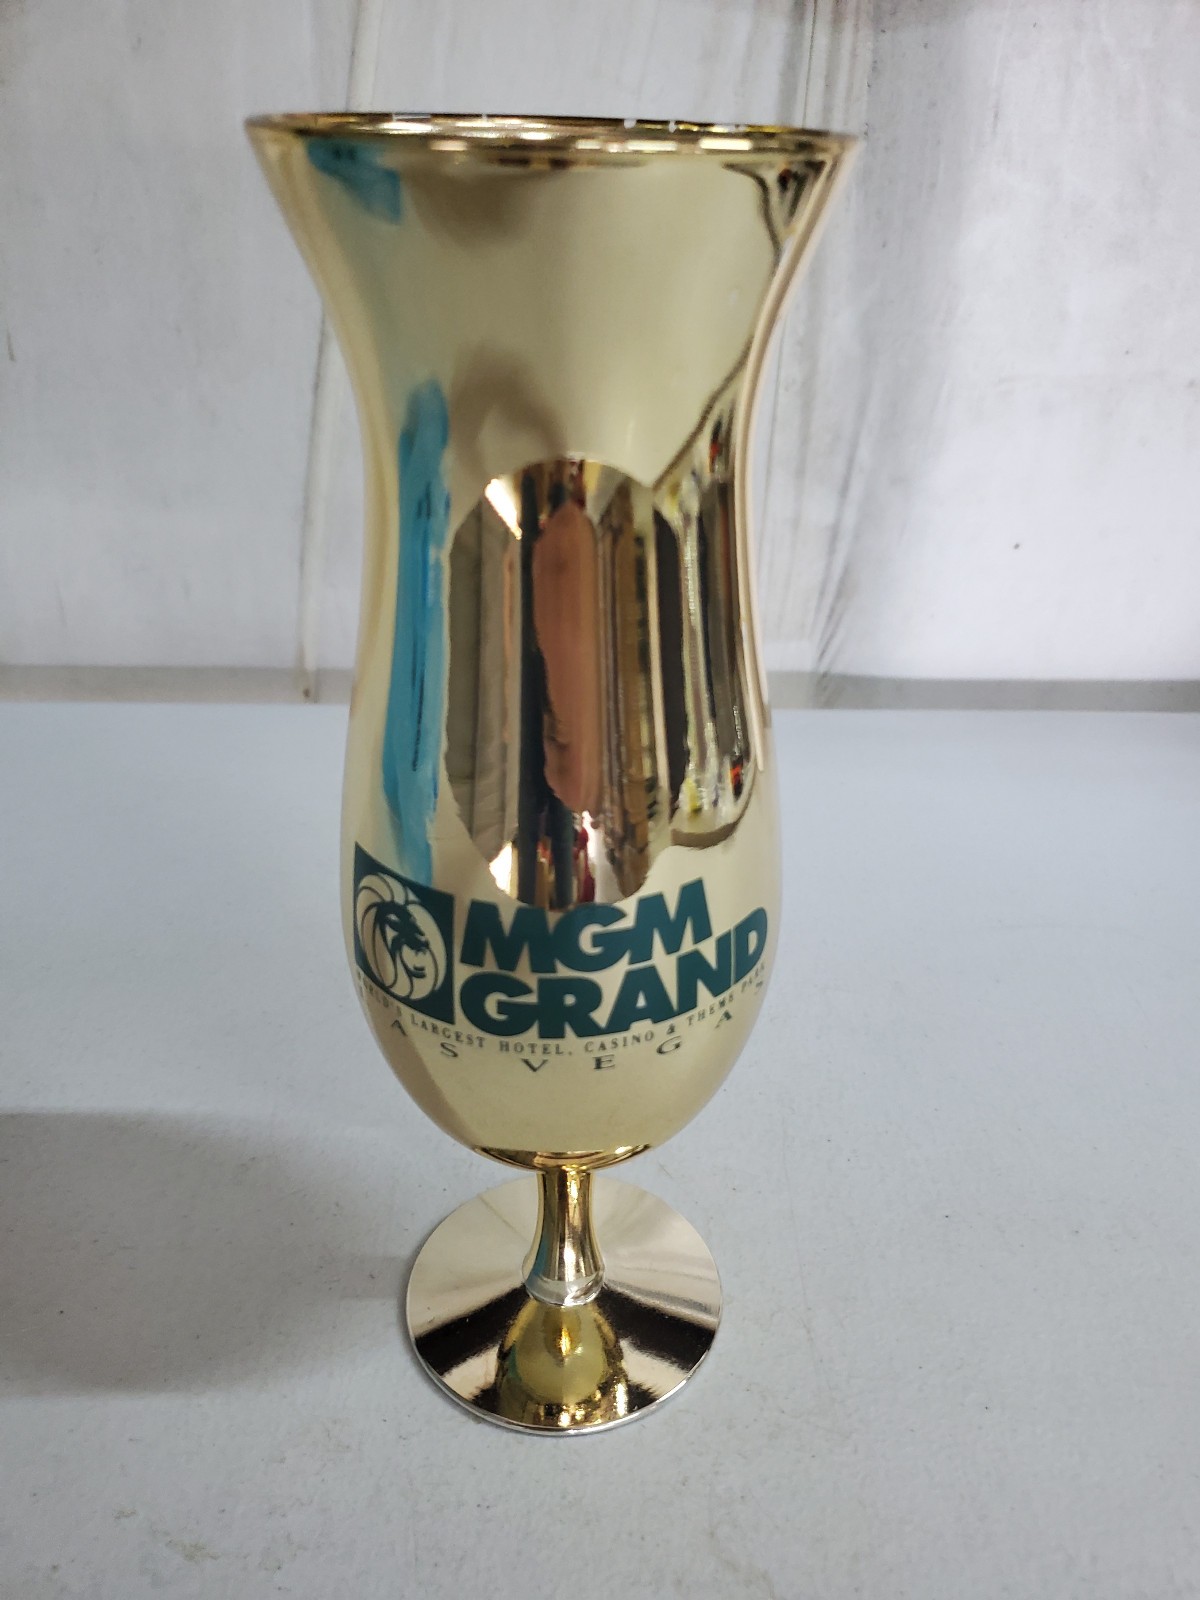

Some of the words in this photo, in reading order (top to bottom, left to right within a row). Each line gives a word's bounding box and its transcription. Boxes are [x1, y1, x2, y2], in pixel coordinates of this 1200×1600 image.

[460, 877, 712, 973] MGM
[460, 907, 768, 1039] GRAND
[411, 1012, 487, 1049] LARGEST
[584, 1030, 654, 1053] CASINO
[666, 1022, 677, 1035] &
[686, 990, 734, 1027] THEME
